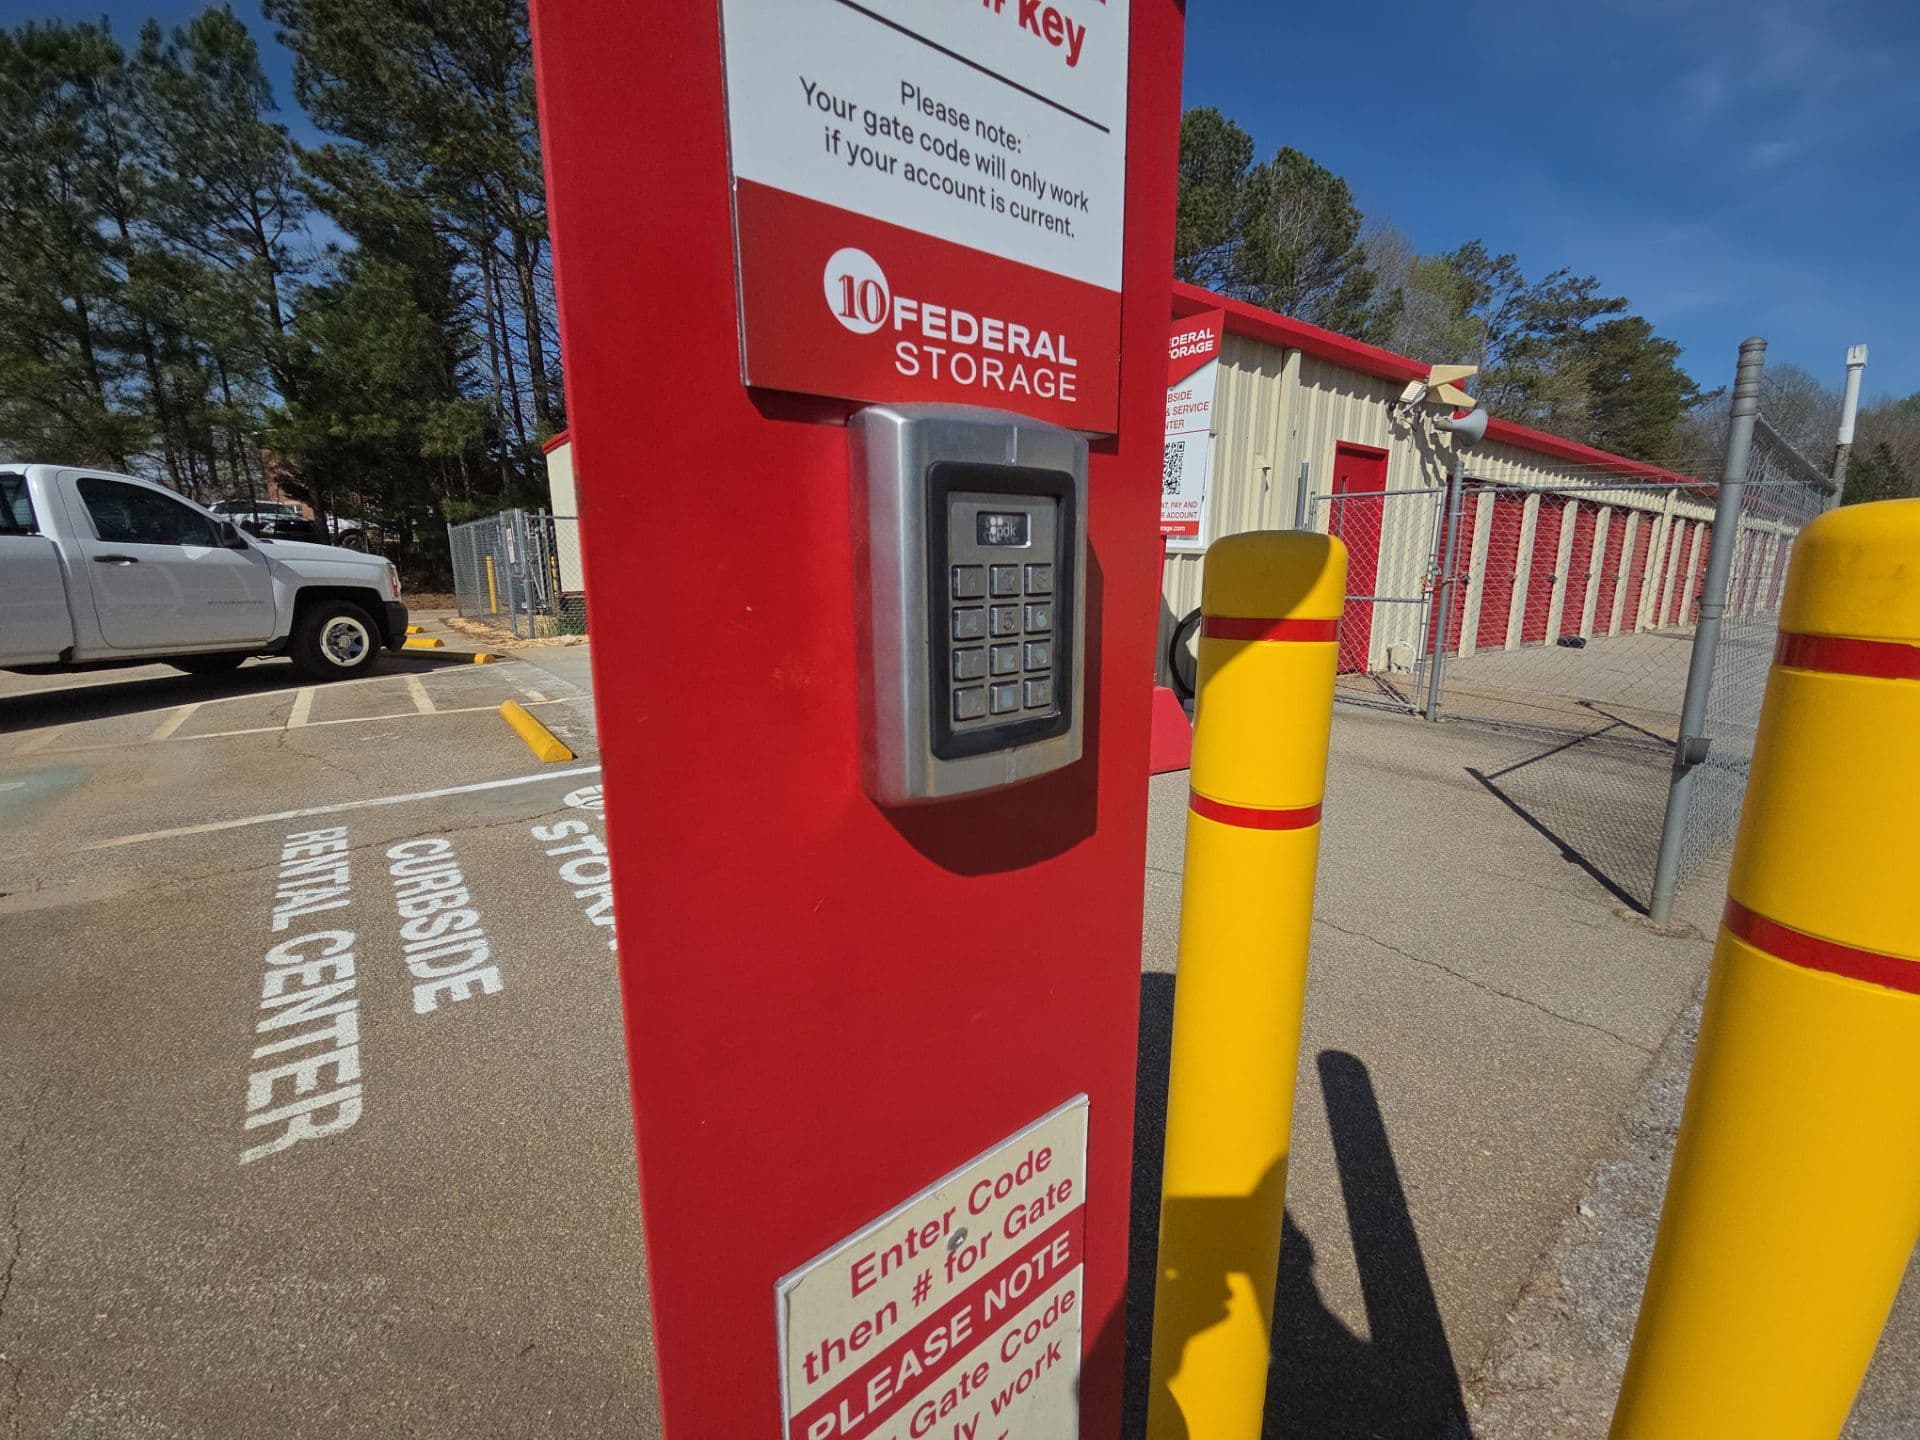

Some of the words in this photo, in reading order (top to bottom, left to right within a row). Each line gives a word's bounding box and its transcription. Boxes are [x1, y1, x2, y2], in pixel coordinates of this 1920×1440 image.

[1018, 0, 1087, 68] key
[800, 76, 857, 122] Your
[863, 109, 914, 145] gate
[920, 132, 970, 166] code
[975, 153, 1006, 181] will
[1011, 169, 1046, 200] only
[1050, 182, 1089, 213] work
[901, 80, 970, 131] Please
[976, 118, 1021, 154] note:
[825, 126, 841, 155] if
[847, 140, 897, 175] your
[904, 162, 986, 207] account
[991, 188, 1006, 213] is
[1010, 201, 1075, 238] current.
[837, 274, 888, 325] 10
[893, 295, 1078, 366] FEDERAL
[1169, 328, 1214, 347] DERAL
[894, 341, 1077, 402] STORAGE
[1168, 340, 1213, 359] ORAGE
[1173, 401, 1209, 415] SERVICE
[271, 826, 352, 932] RENTAL
[386, 837, 504, 1015] CURBSIDE
[239, 929, 363, 1167] CENTER
[851, 1206, 956, 1298] Enter
[967, 1146, 1052, 1216] Code
[802, 1300, 898, 1385] then
[912, 1268, 932, 1308] #
[944, 1230, 993, 1284] for
[1003, 1177, 1073, 1240] Gate
[806, 1304, 972, 1440] PLEASE
[984, 1229, 1070, 1322] NOTE
[909, 1361, 990, 1440] Gate
[1000, 1288, 1076, 1364] Code
[990, 1338, 1062, 1417] work
